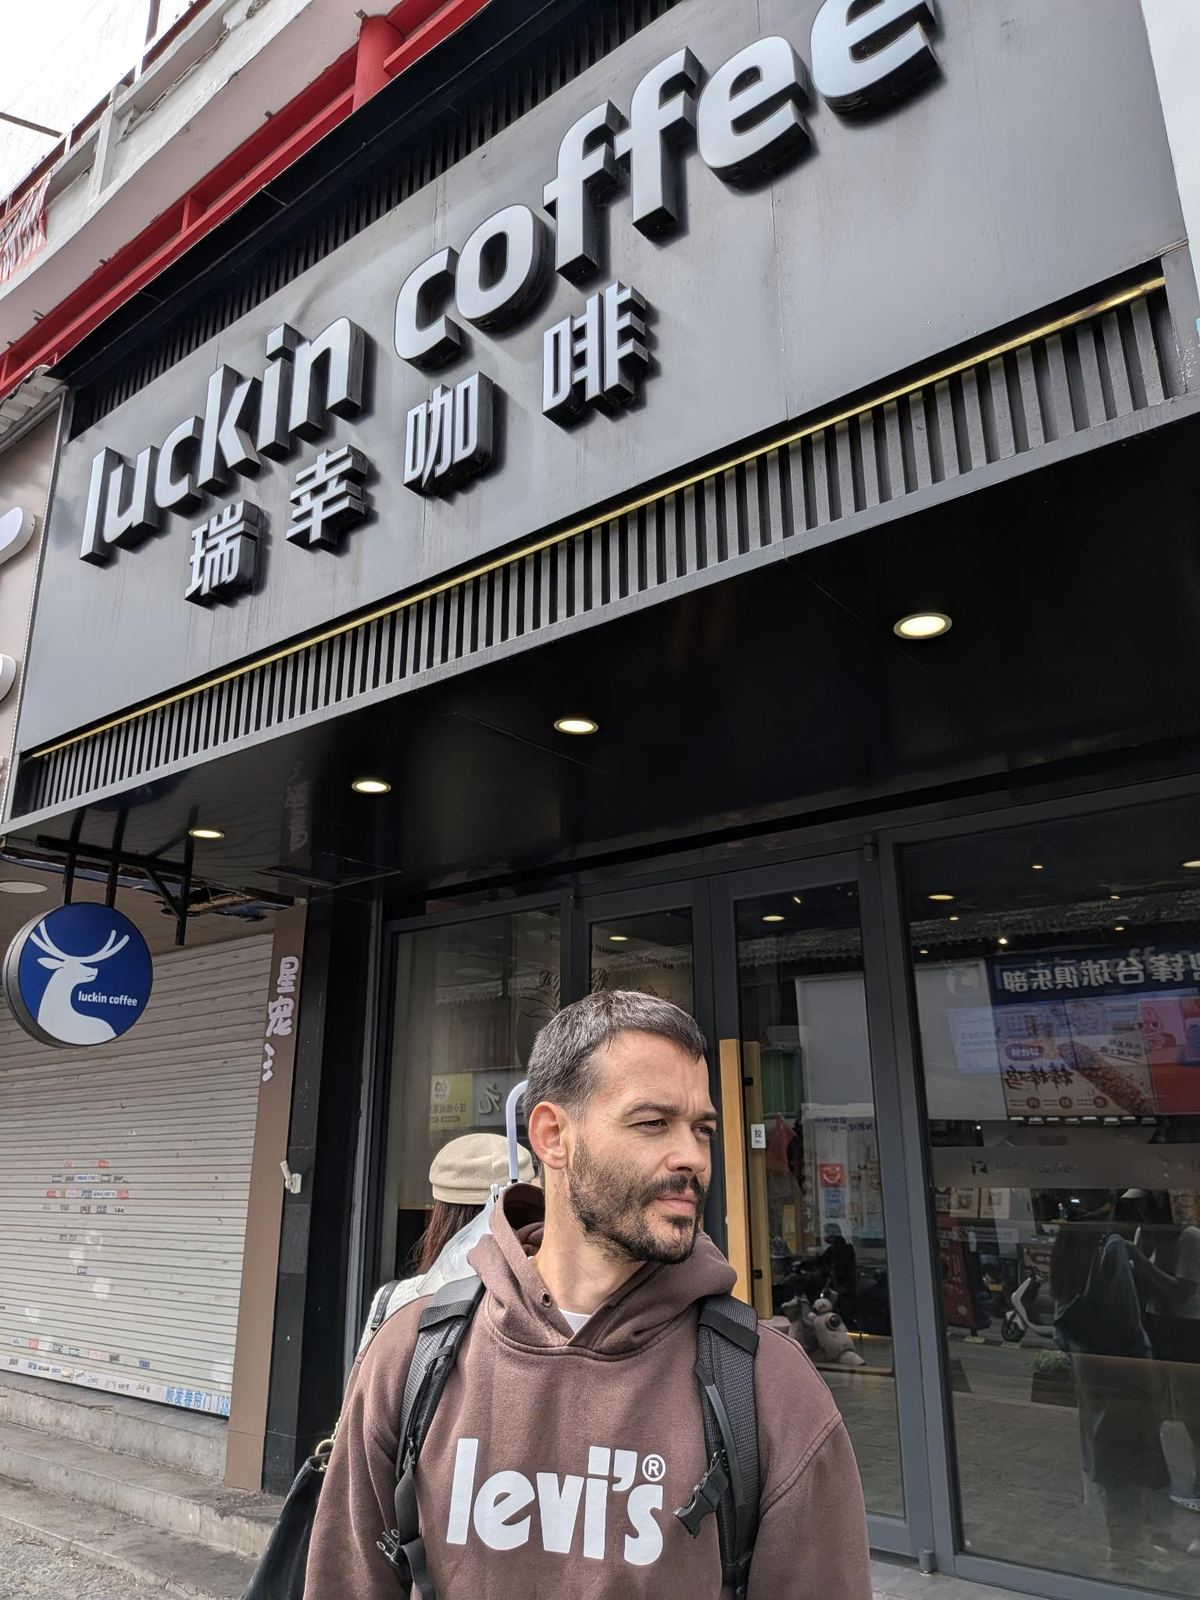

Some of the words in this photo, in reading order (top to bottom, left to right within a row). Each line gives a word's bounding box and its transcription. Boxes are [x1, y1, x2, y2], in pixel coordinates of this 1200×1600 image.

[80, 317, 366, 566] luckin
[394, 0, 938, 368] coffee
[185, 281, 647, 602] 瑞幸咖啡
[78, 990, 108, 1004] luckin
[109, 994, 138, 1007] coffee
[446, 1438, 664, 1566] levi's
